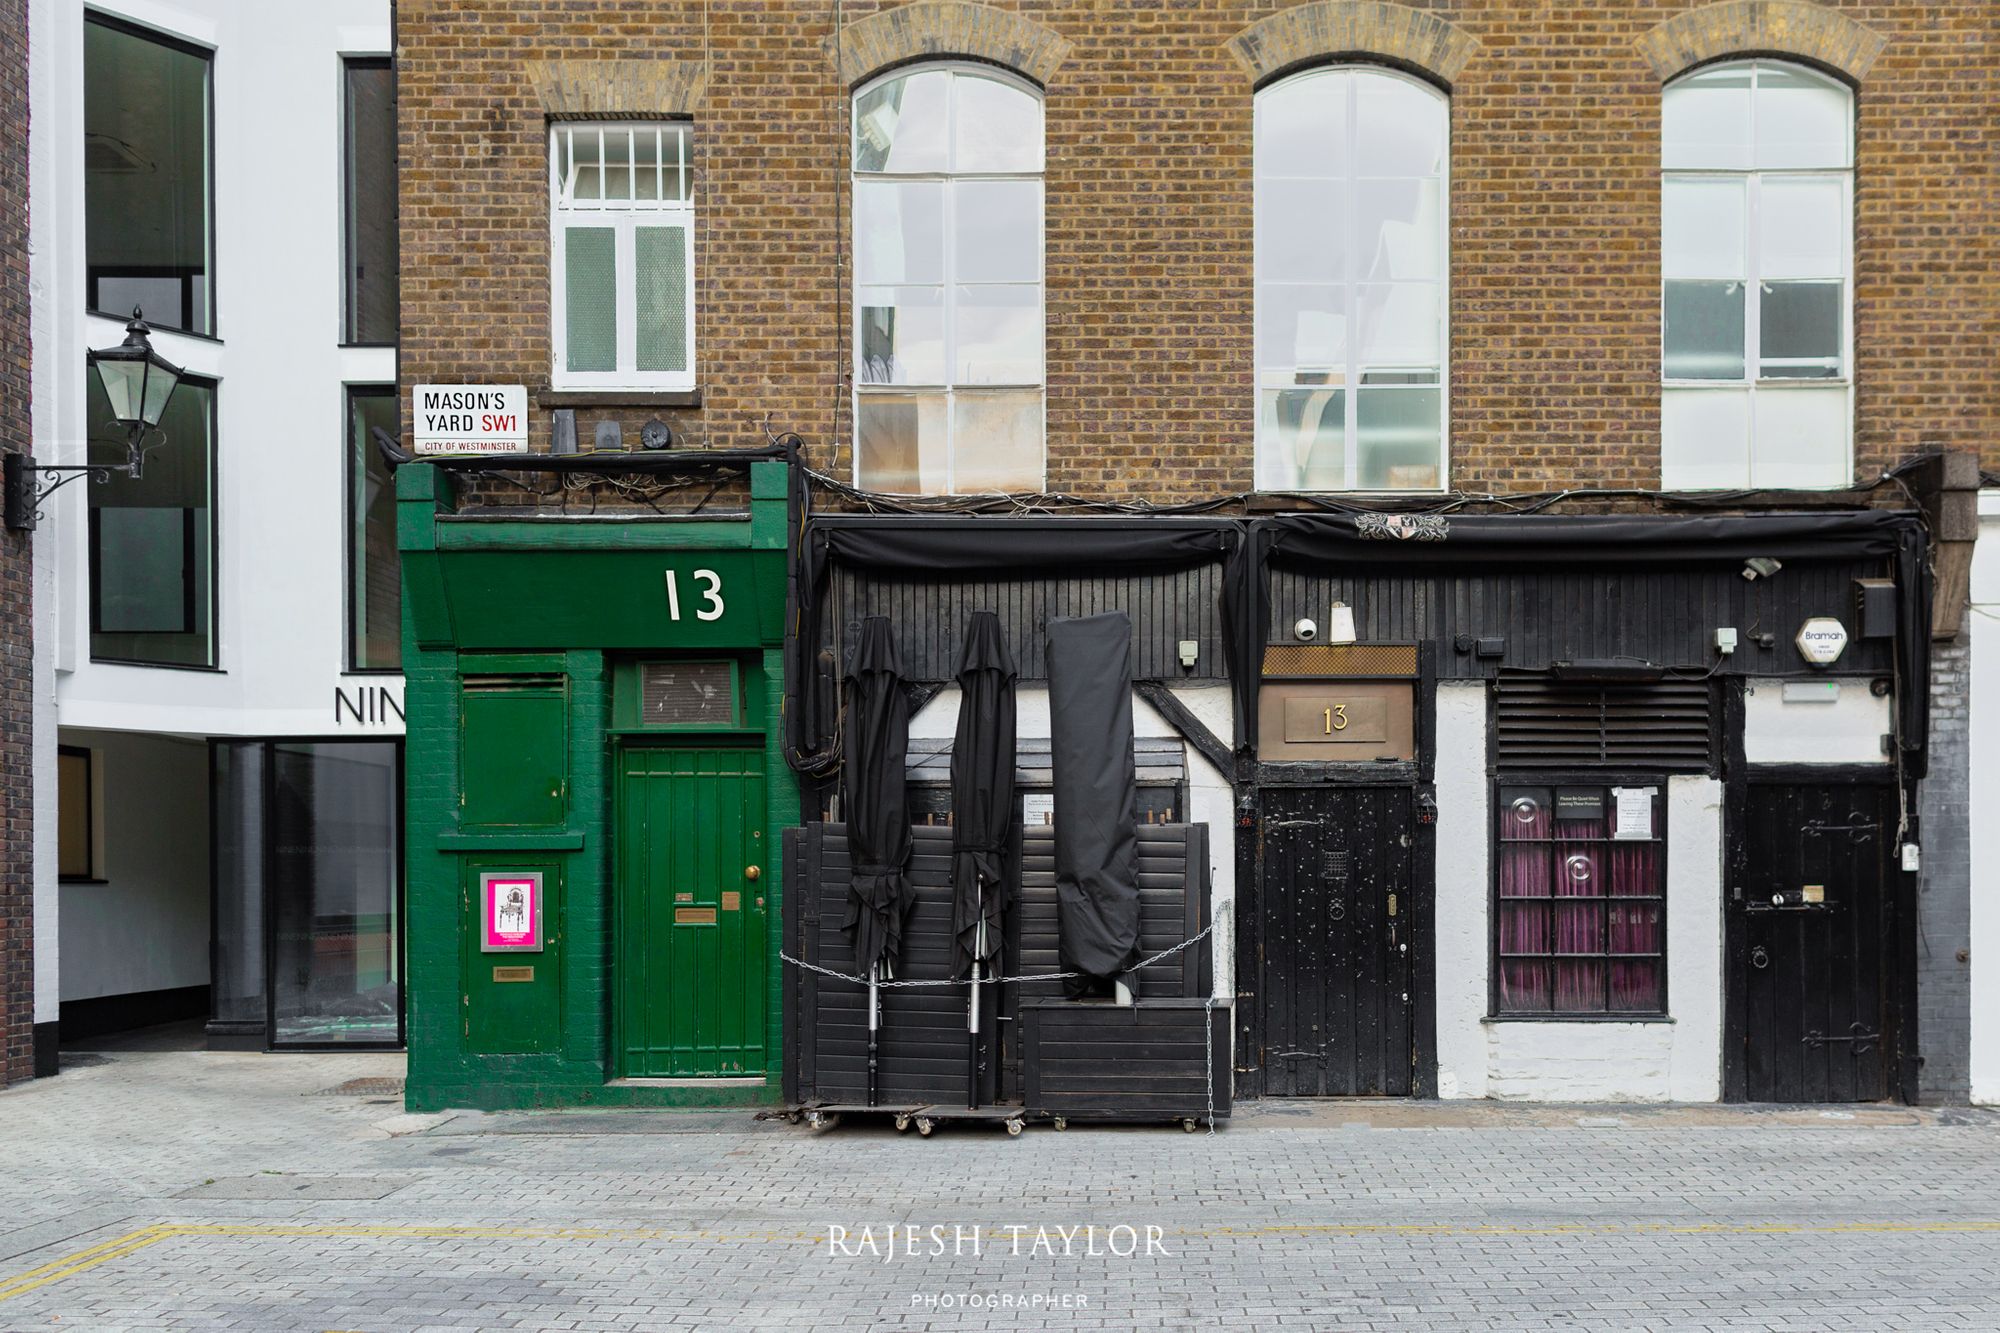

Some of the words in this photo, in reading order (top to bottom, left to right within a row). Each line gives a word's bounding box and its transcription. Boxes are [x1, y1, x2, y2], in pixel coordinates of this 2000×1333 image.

[424, 392, 505, 410] MASON'S
[426, 414, 473, 432] YARD
[482, 414, 516, 432] SW1
[425, 442, 443, 451] CITY
[446, 442, 455, 451] OF
[458, 442, 516, 451] WESTMINSTER
[665, 569, 724, 621] 13
[1805, 631, 1843, 640] Bramah
[1324, 704, 1348, 735] 13
